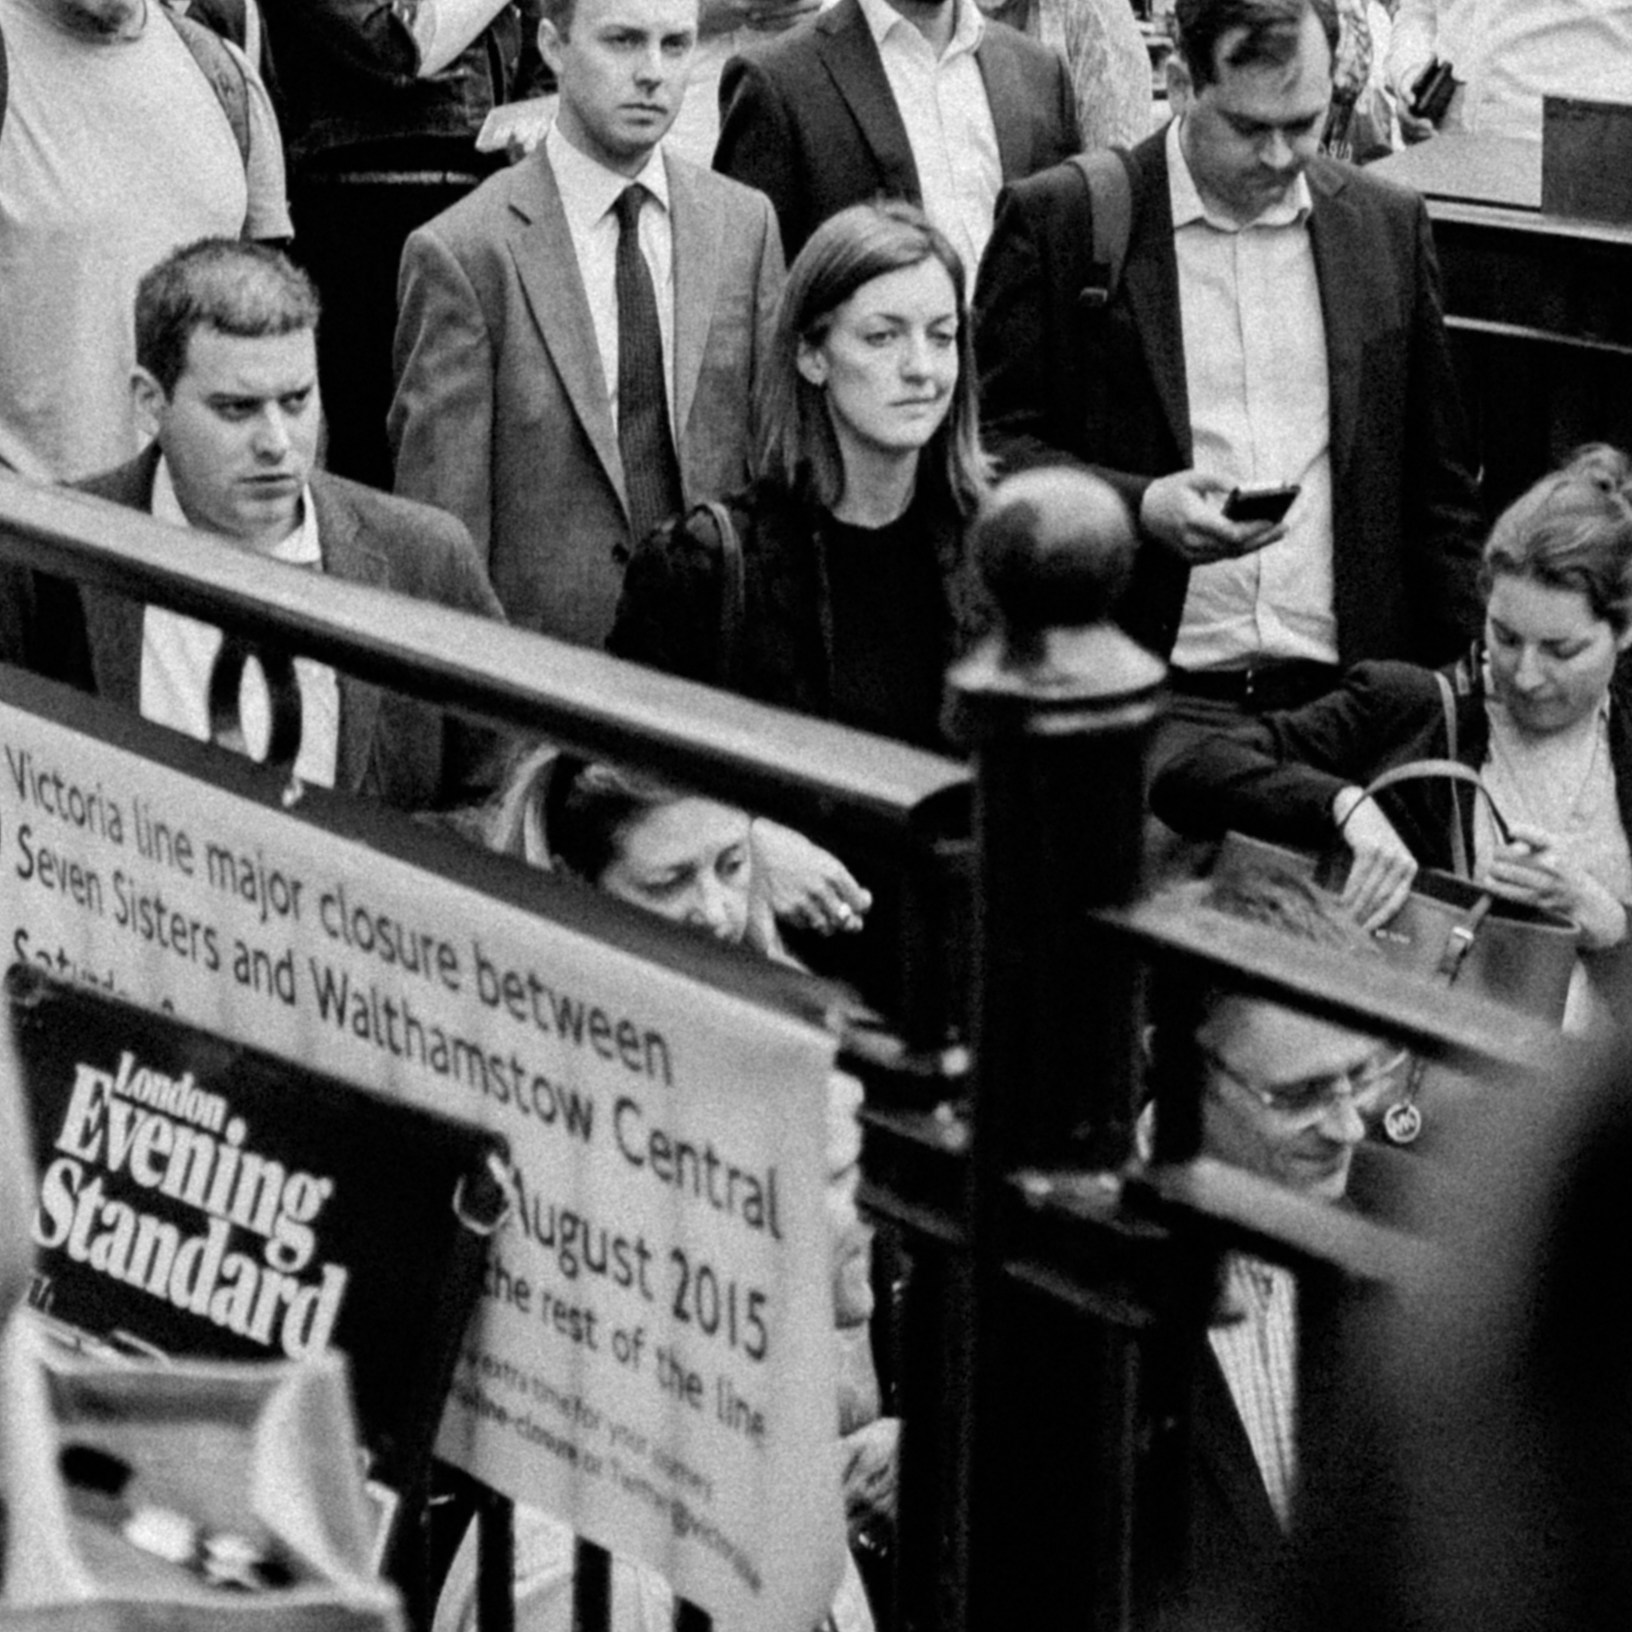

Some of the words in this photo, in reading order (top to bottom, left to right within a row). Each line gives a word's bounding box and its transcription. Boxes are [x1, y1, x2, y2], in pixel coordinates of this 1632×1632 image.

[5, 744, 124, 845] Victoria
[132, 795, 194, 877] line
[206, 840, 304, 924] major
[319, 884, 460, 991] closure
[474, 941, 672, 1087] between
[16, 824, 104, 917] Seven
[112, 869, 221, 971] Sisters
[232, 940, 297, 1007] and
[310, 958, 594, 1144] Walthamstow
[614, 1097, 782, 1241] Central
[115, 1050, 228, 1132] London
[30, 1158, 349, 1360] Standard
[54, 1063, 335, 1274] Evening
[542, 1292, 599, 1352] rest
[612, 1325, 645, 1370] of
[655, 1346, 704, 1410] the
[716, 1373, 766, 1440] line
[670, 1247, 766, 1362] 2015
